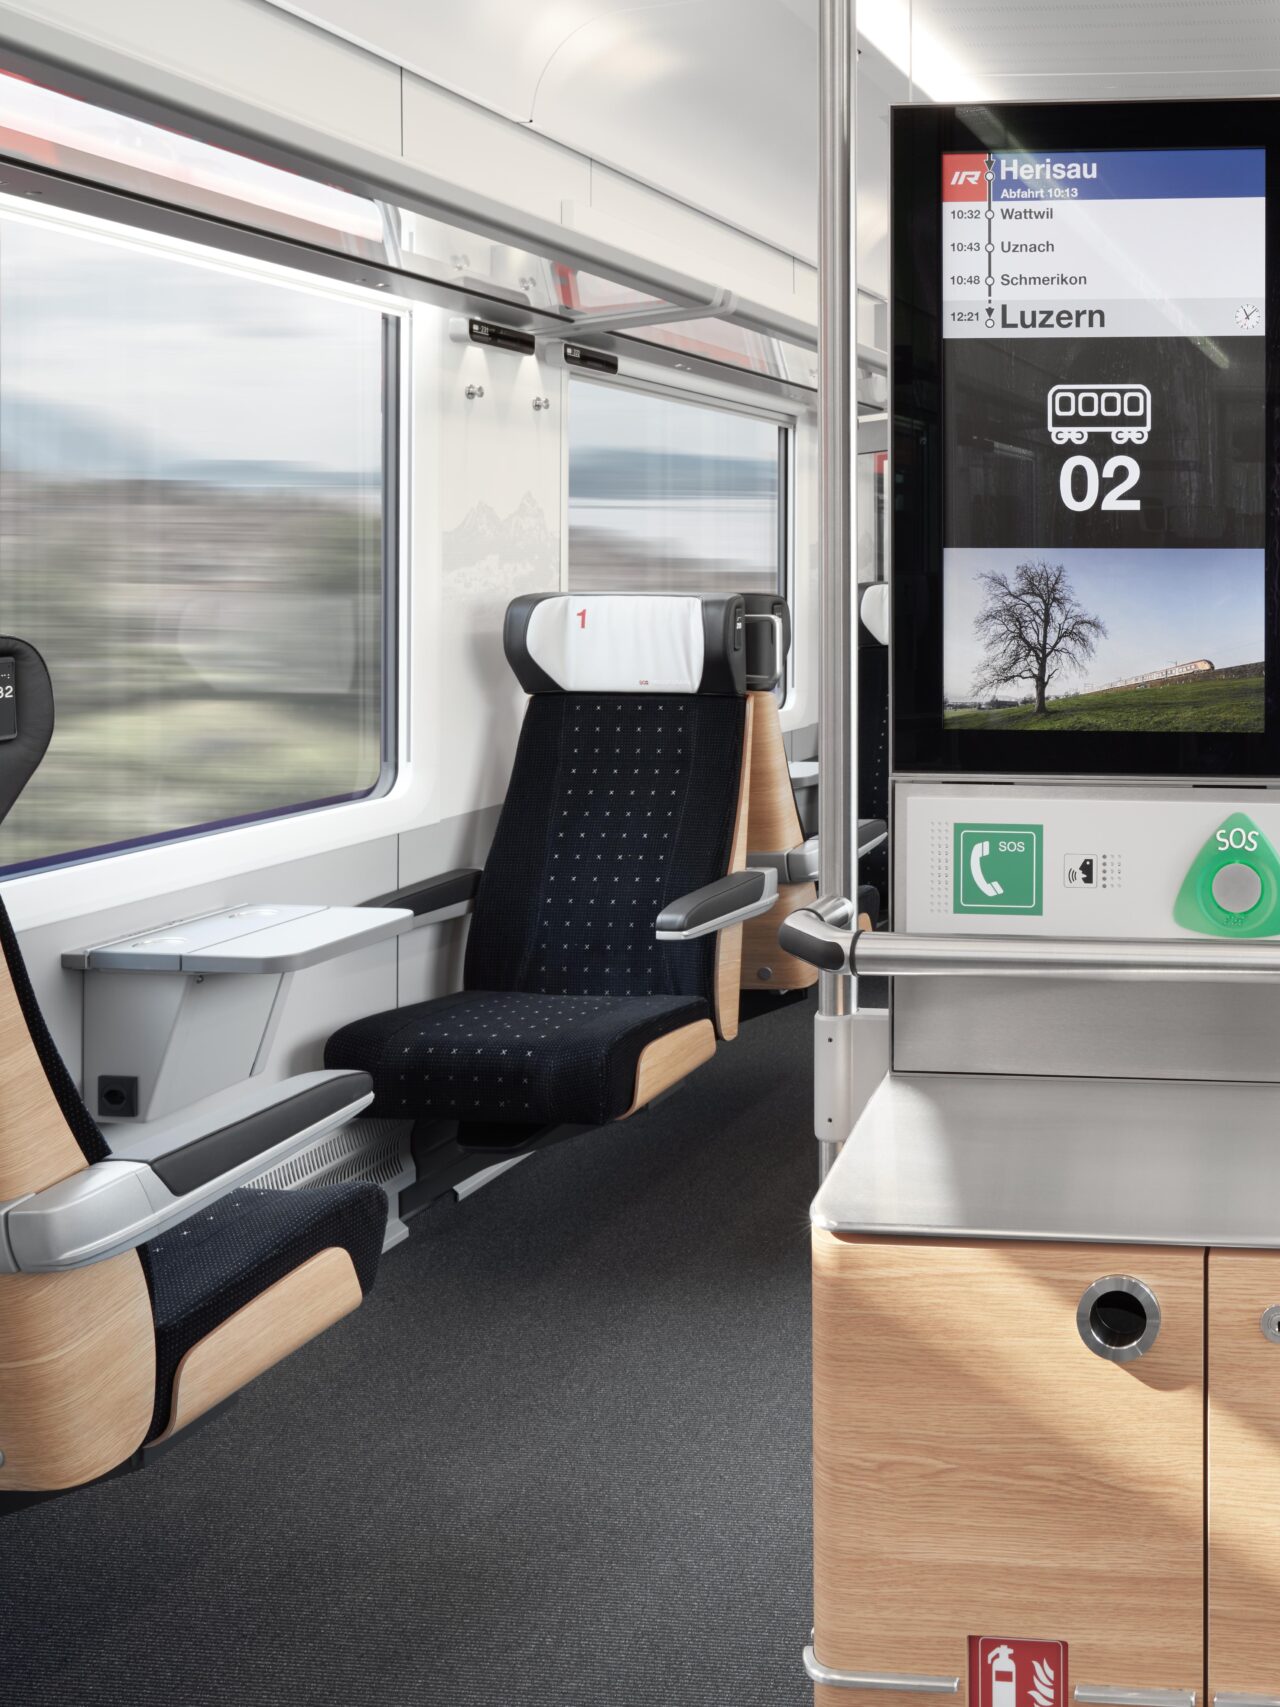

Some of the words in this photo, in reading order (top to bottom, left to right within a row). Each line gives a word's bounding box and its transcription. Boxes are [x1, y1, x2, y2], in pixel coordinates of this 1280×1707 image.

[1001, 159, 1097, 180] Herisau
[951, 171, 981, 185] IR
[1001, 188, 1044, 199] Abfahrt
[1048, 188, 1079, 198] 10:13
[950, 210, 980, 219] 10:32
[1001, 208, 1052, 219] Wattwil
[950, 243, 980, 252] 10:43
[1001, 241, 1054, 253] Uznach
[950, 276, 980, 285] 10:48
[1001, 274, 1086, 285] Schmerikon
[950, 312, 979, 321] 12:21
[1002, 304, 1104, 328] Luzern
[1060, 455, 1140, 511] 02
[576, 609, 587, 629] 1
[998, 841, 1025, 853] SOS
[1216, 828, 1259, 852] SOS
